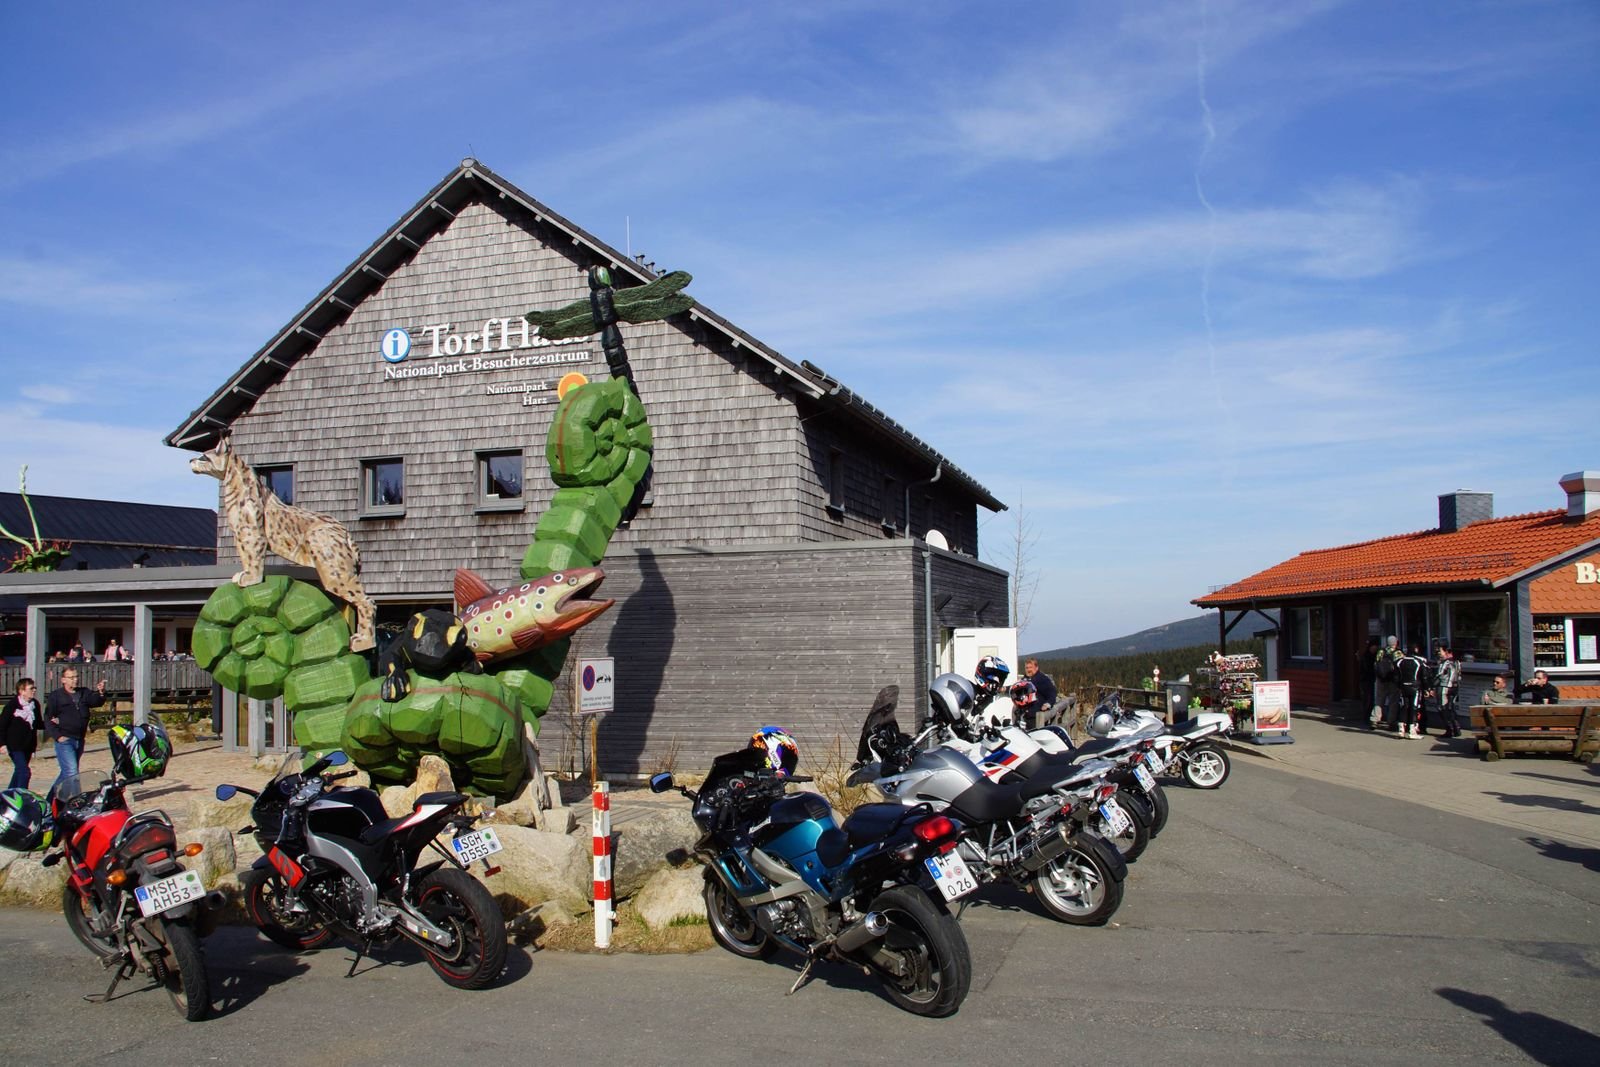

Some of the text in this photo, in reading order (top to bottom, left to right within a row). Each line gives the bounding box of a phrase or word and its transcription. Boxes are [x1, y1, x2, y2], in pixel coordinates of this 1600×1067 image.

[421, 316, 590, 358] TorfHa
[384, 349, 590, 380] Nationalpark-Besucherzentrum
[486, 380, 548, 395] Nationalpark
[523, 396, 548, 406] Harz
[1575, 562, 1600, 584] B
[460, 832, 483, 850] SGH
[460, 843, 489, 863] D 555
[147, 878, 178, 899] MSH
[956, 877, 972, 893] 26
[153, 887, 191, 911] AH53
